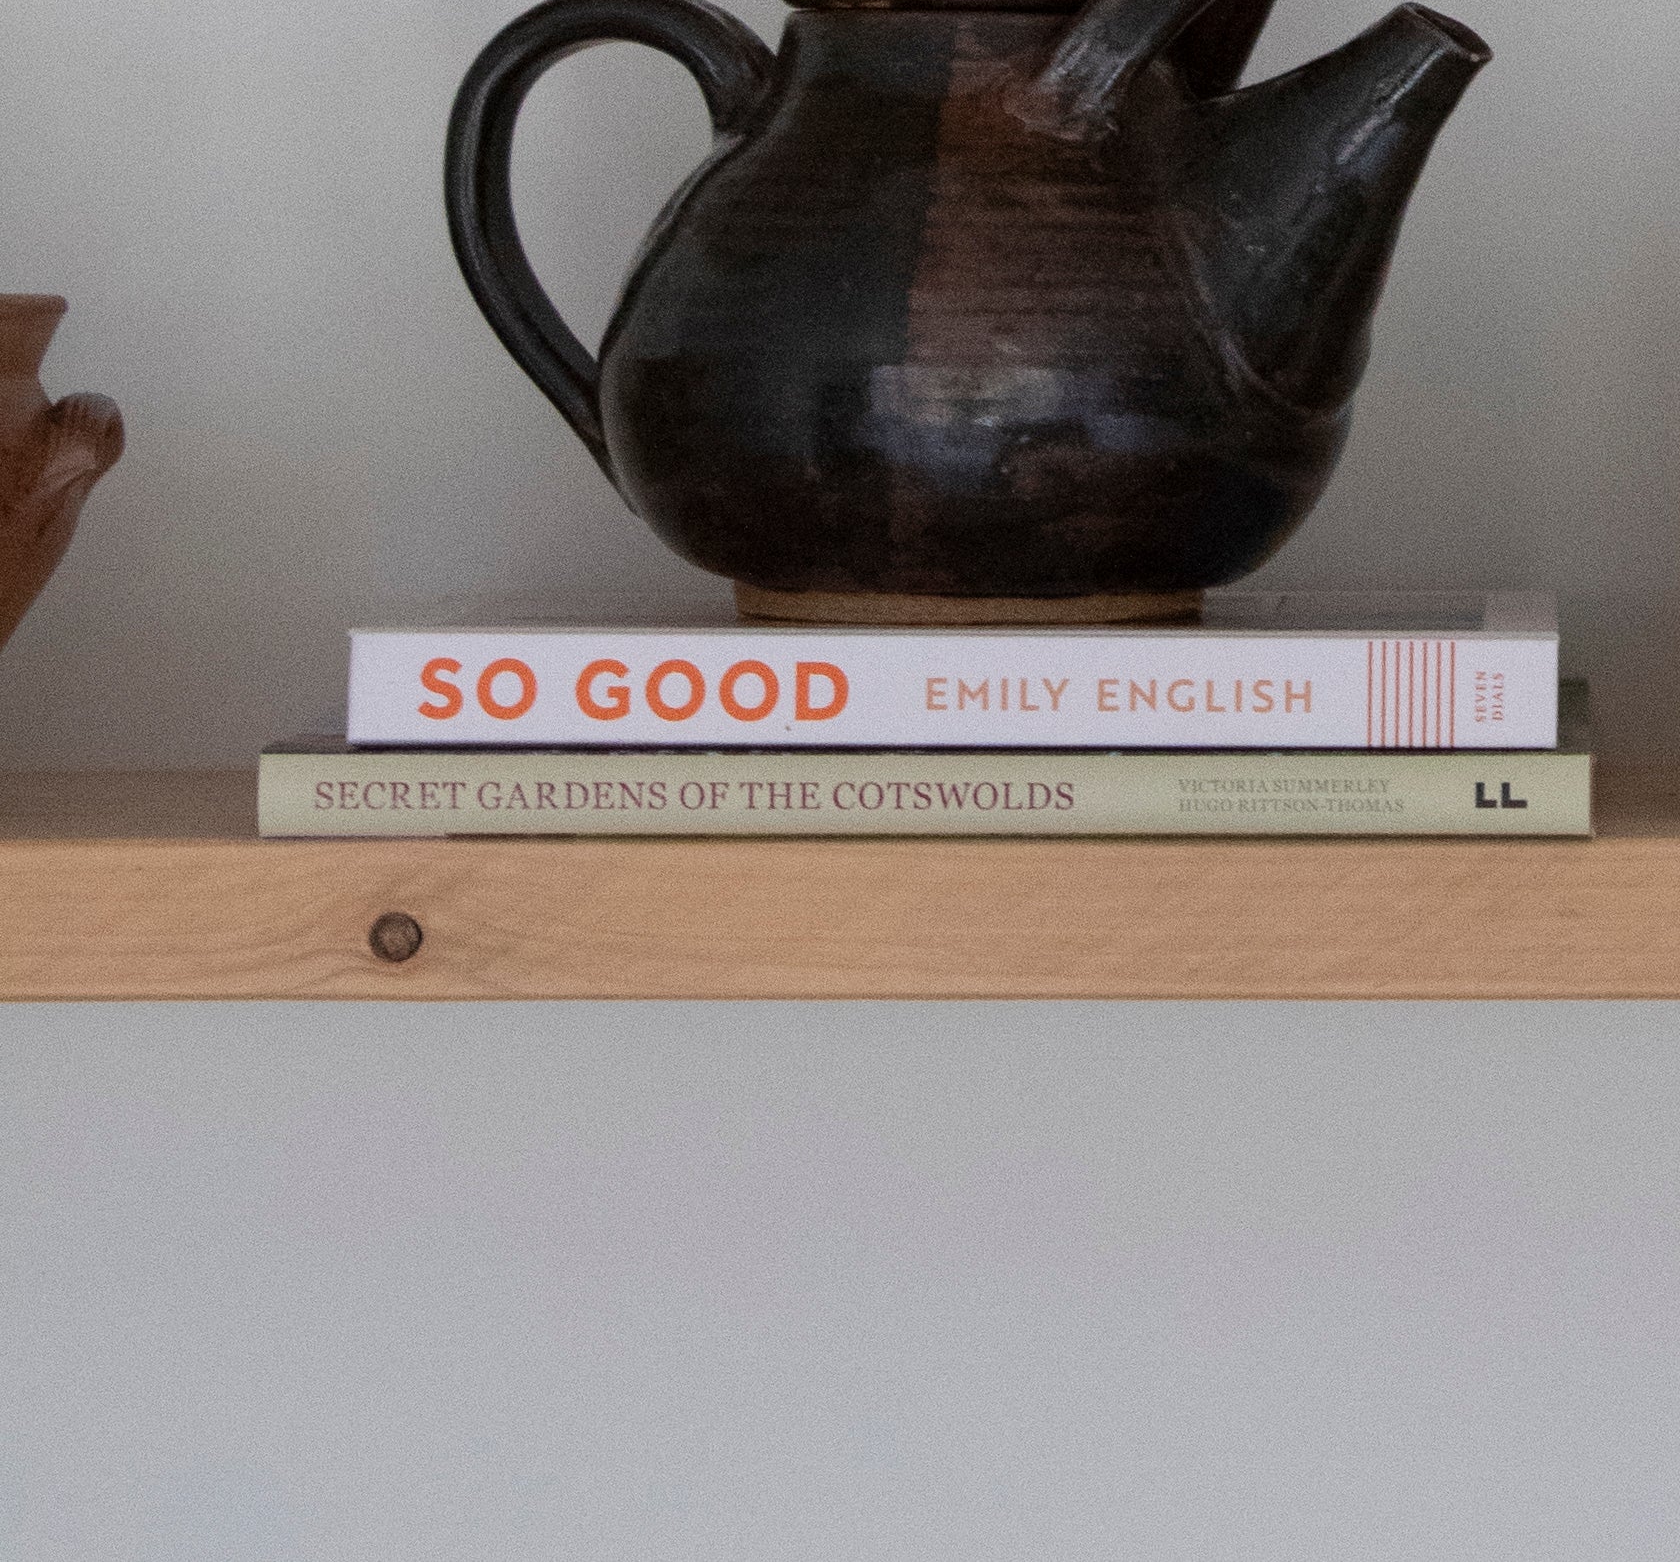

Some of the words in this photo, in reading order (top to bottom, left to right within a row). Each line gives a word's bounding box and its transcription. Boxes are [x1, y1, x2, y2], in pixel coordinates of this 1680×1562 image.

[417, 657, 538, 721] SO
[575, 658, 850, 722] GOOD
[925, 676, 1071, 713] EMILY
[1096, 678, 1314, 715] ENGLISH
[1474, 670, 1487, 723] SEVEN
[1491, 672, 1504, 722] DIALS
[314, 780, 467, 811] SECRET
[477, 780, 668, 811] GARDENS
[679, 780, 731, 811] OF
[739, 780, 821, 811] THE
[832, 781, 1075, 812] COTSWOLDS
[1178, 778, 1269, 794] VICTORIA
[1272, 778, 1390, 794] SUMMERLEY
[1178, 798, 1233, 813] HUGO
